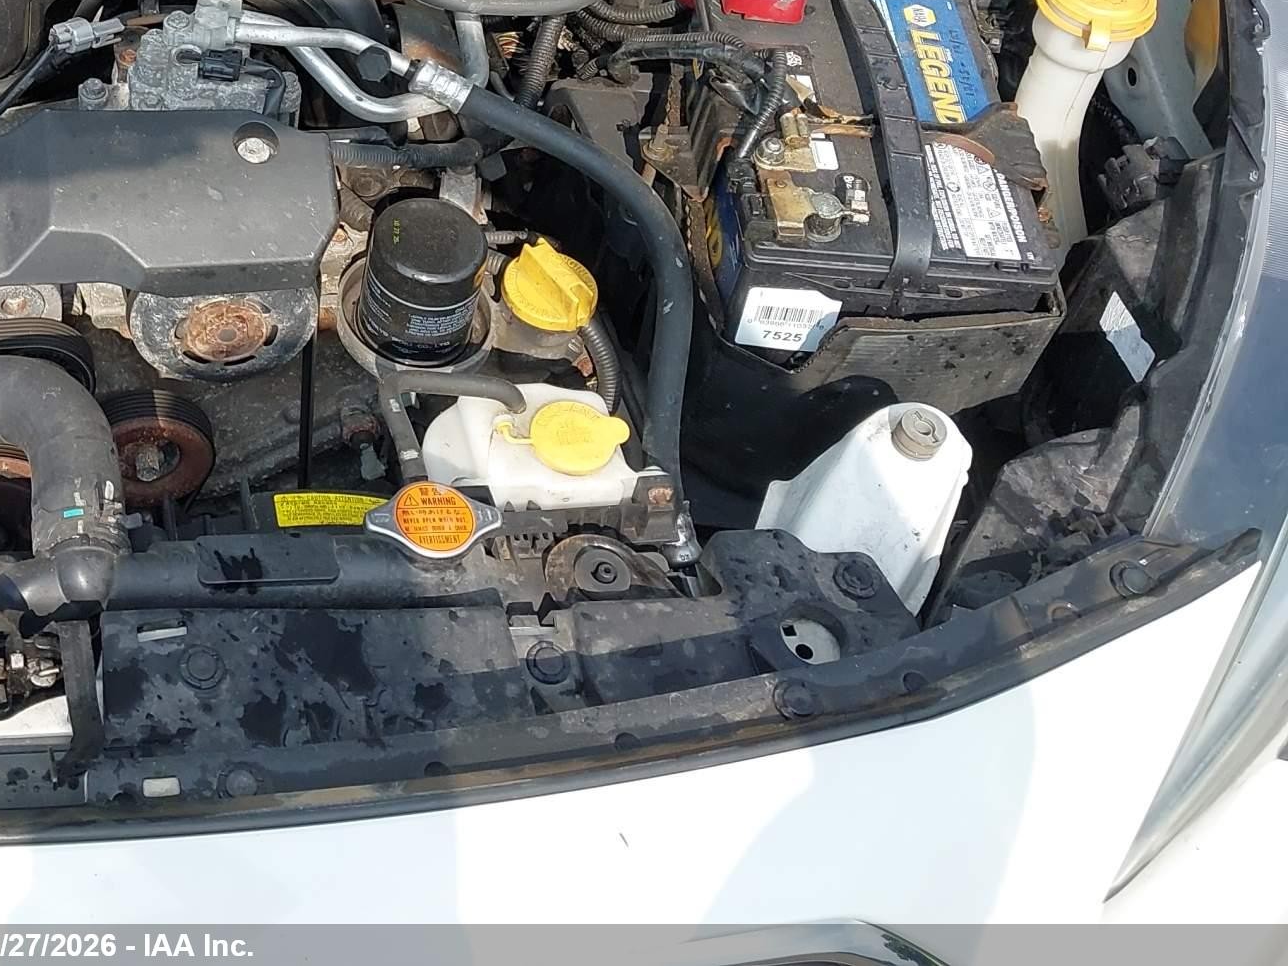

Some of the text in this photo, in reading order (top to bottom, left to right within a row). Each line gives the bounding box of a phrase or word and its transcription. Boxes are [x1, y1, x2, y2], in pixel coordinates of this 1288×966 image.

[910, 29, 967, 124] LEGEND
[762, 330, 803, 342] 7525
[420, 496, 457, 507] WARNING
